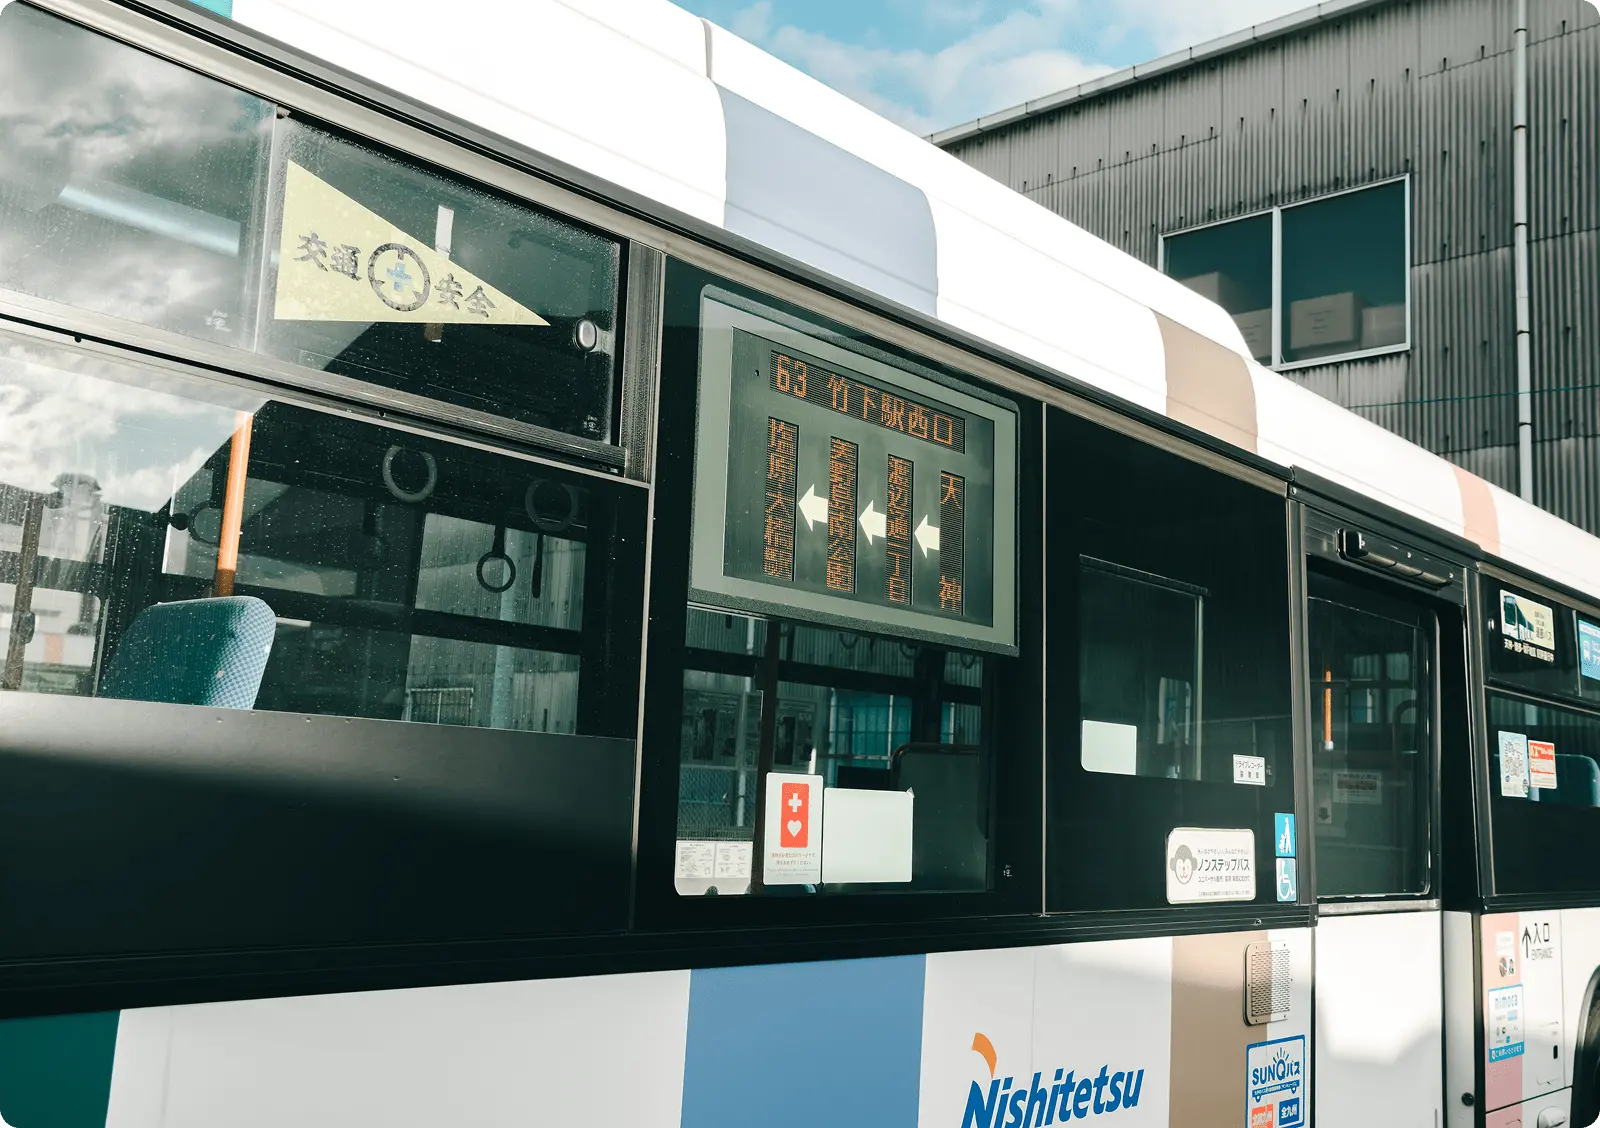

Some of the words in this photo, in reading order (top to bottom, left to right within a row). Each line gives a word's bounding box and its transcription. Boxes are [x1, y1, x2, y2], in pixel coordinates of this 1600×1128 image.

[293, 232, 362, 282] 交通
[434, 273, 498, 318] 安全
[776, 353, 808, 399] 63
[826, 373, 953, 446] 竹下駅西口
[1197, 858, 1251, 872] ノンステップバス
[1533, 922, 1551, 944] 入口
[1252, 1058, 1300, 1086] SUNQパス
[960, 1064, 1145, 1128] Nishitetsu
